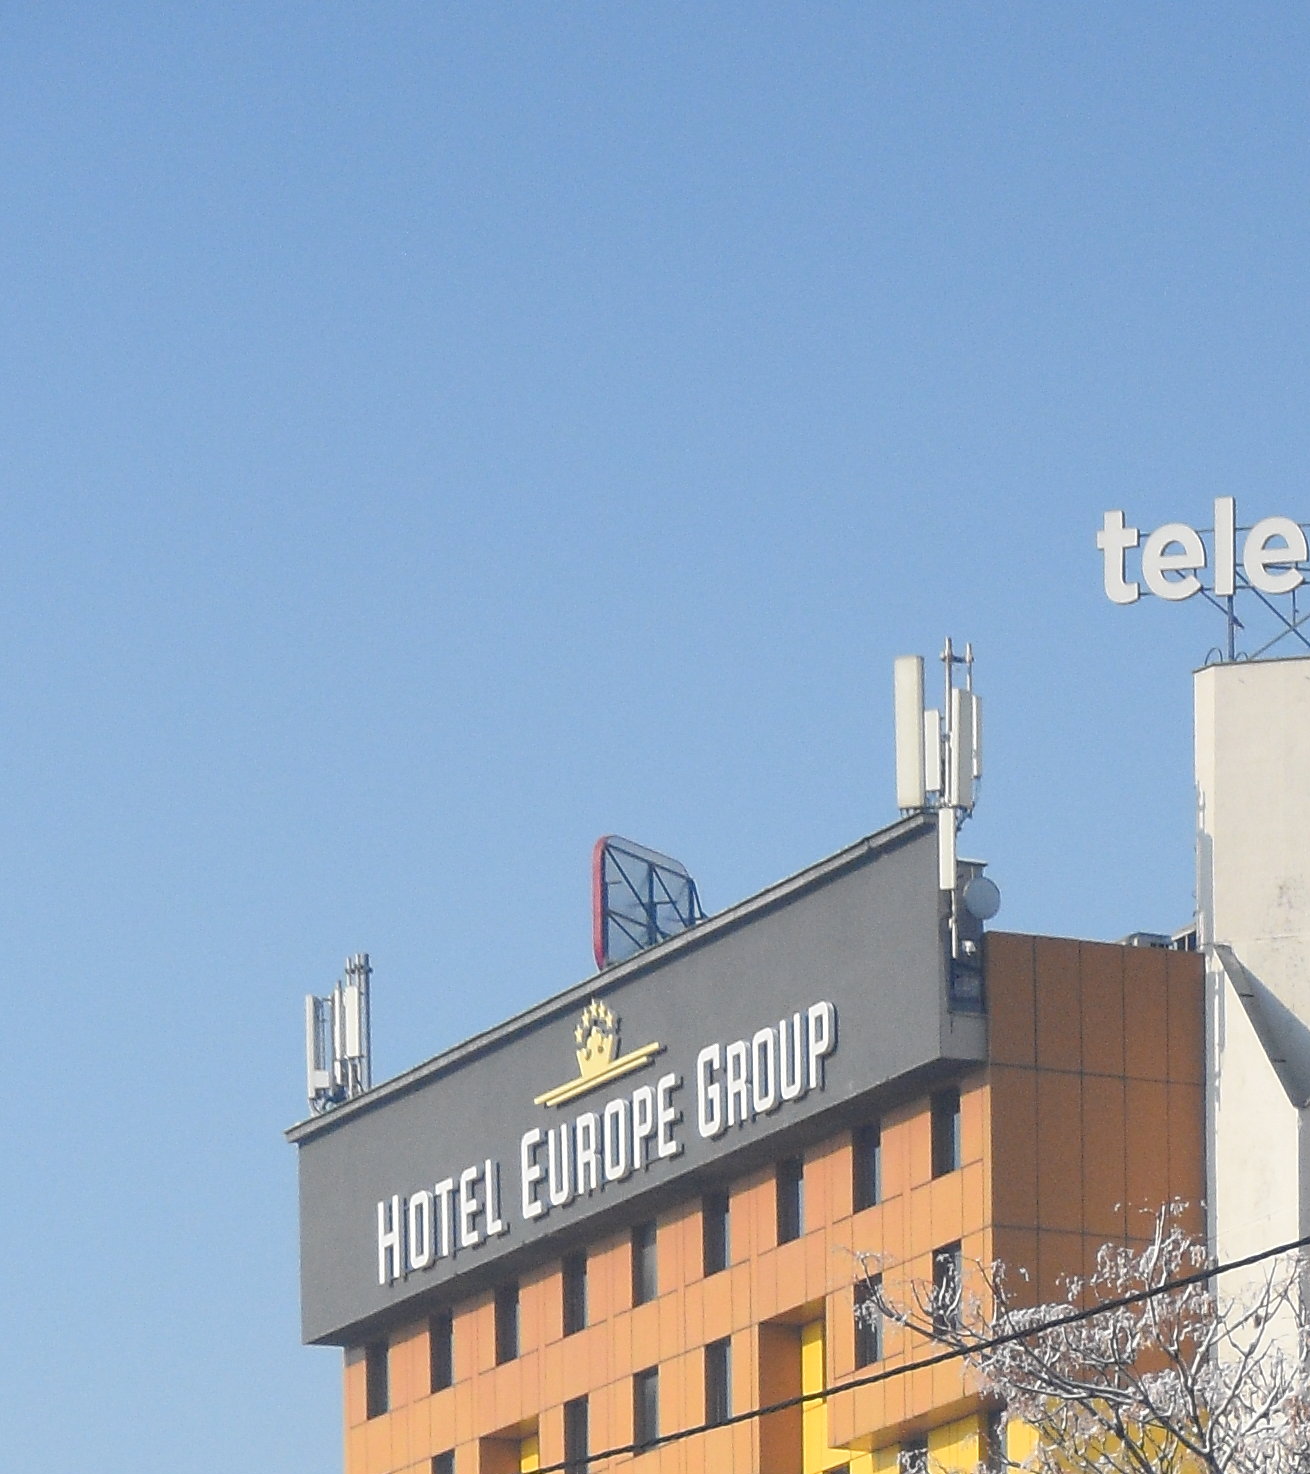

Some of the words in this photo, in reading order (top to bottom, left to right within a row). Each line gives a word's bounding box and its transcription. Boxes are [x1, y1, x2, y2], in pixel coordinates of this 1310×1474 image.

[377, 1158, 503, 1285] HOTEL
[521, 1072, 679, 1220] EUROPE
[697, 1001, 832, 1139] GROUP
